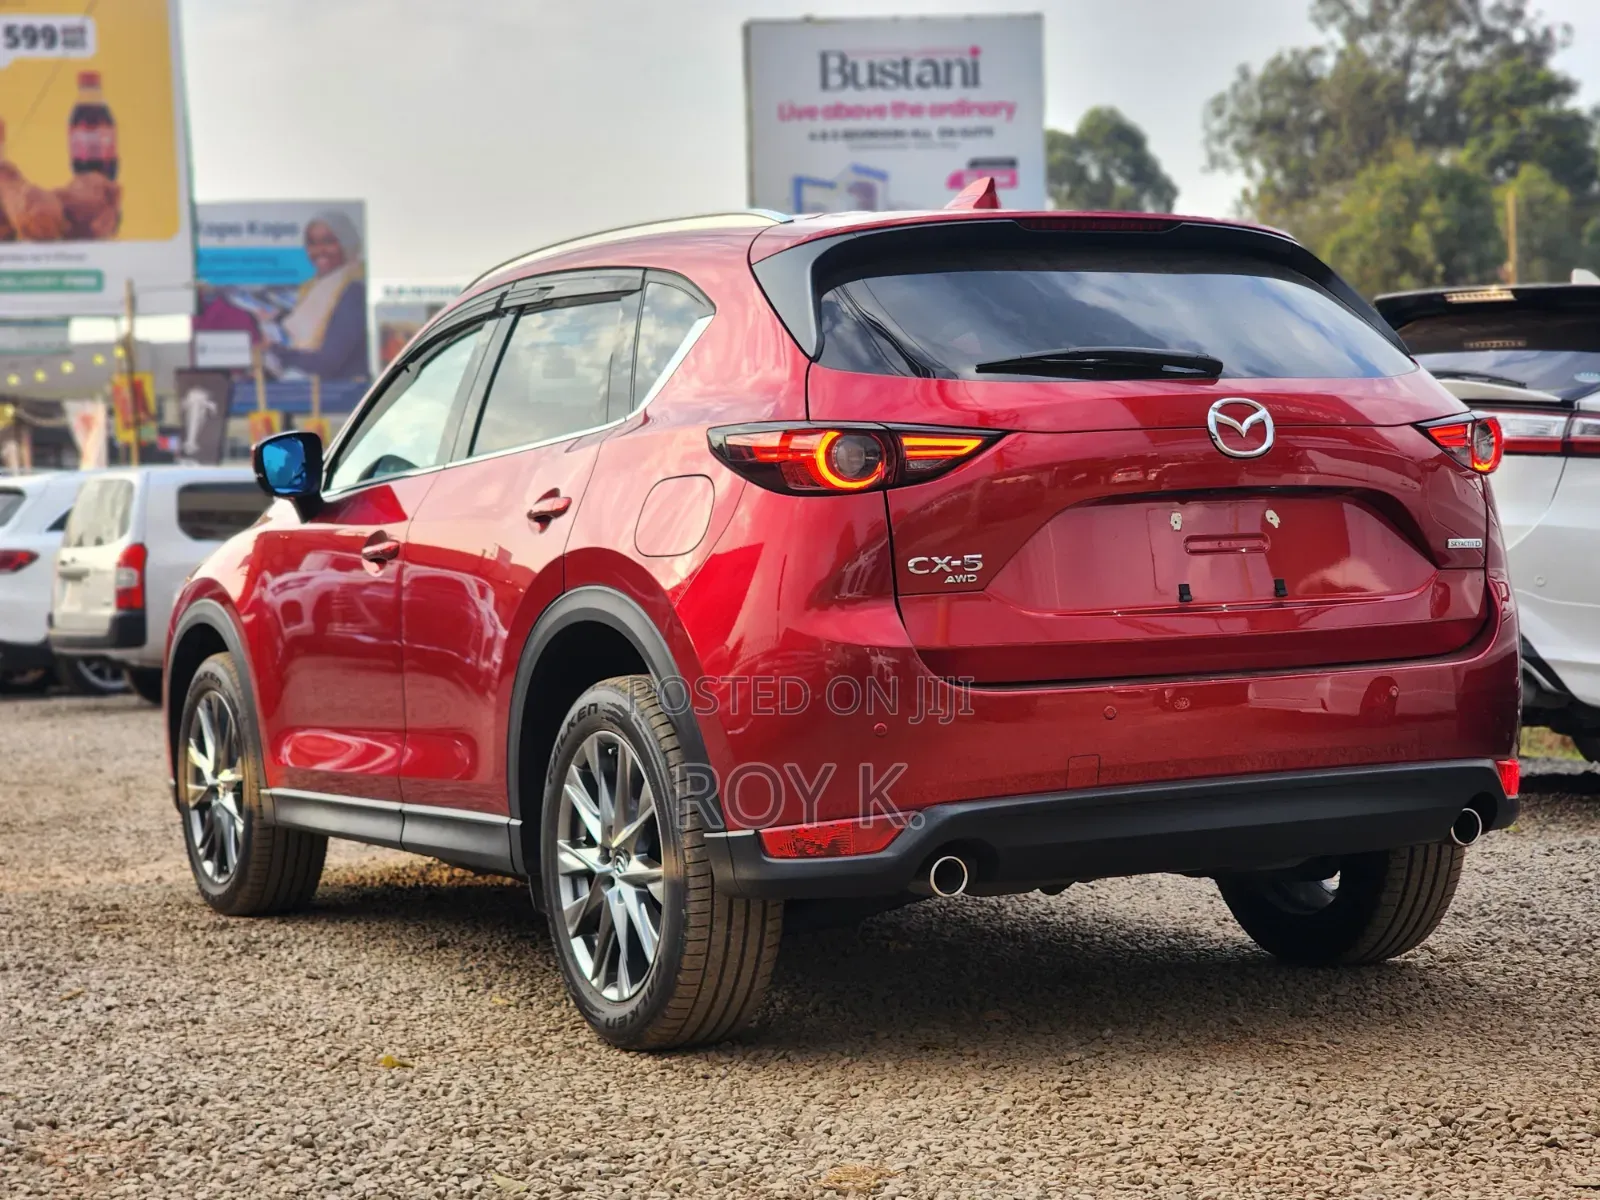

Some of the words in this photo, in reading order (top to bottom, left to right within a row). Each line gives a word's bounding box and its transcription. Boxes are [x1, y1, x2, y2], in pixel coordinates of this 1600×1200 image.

[3, 23, 58, 51] 599
[819, 45, 982, 92] Bustani
[776, 100, 819, 122] Live
[820, 99, 887, 121] above
[889, 98, 925, 120] the
[928, 96, 1016, 124] ordinary
[907, 553, 983, 574] CX-5
[944, 574, 978, 583] AWD
